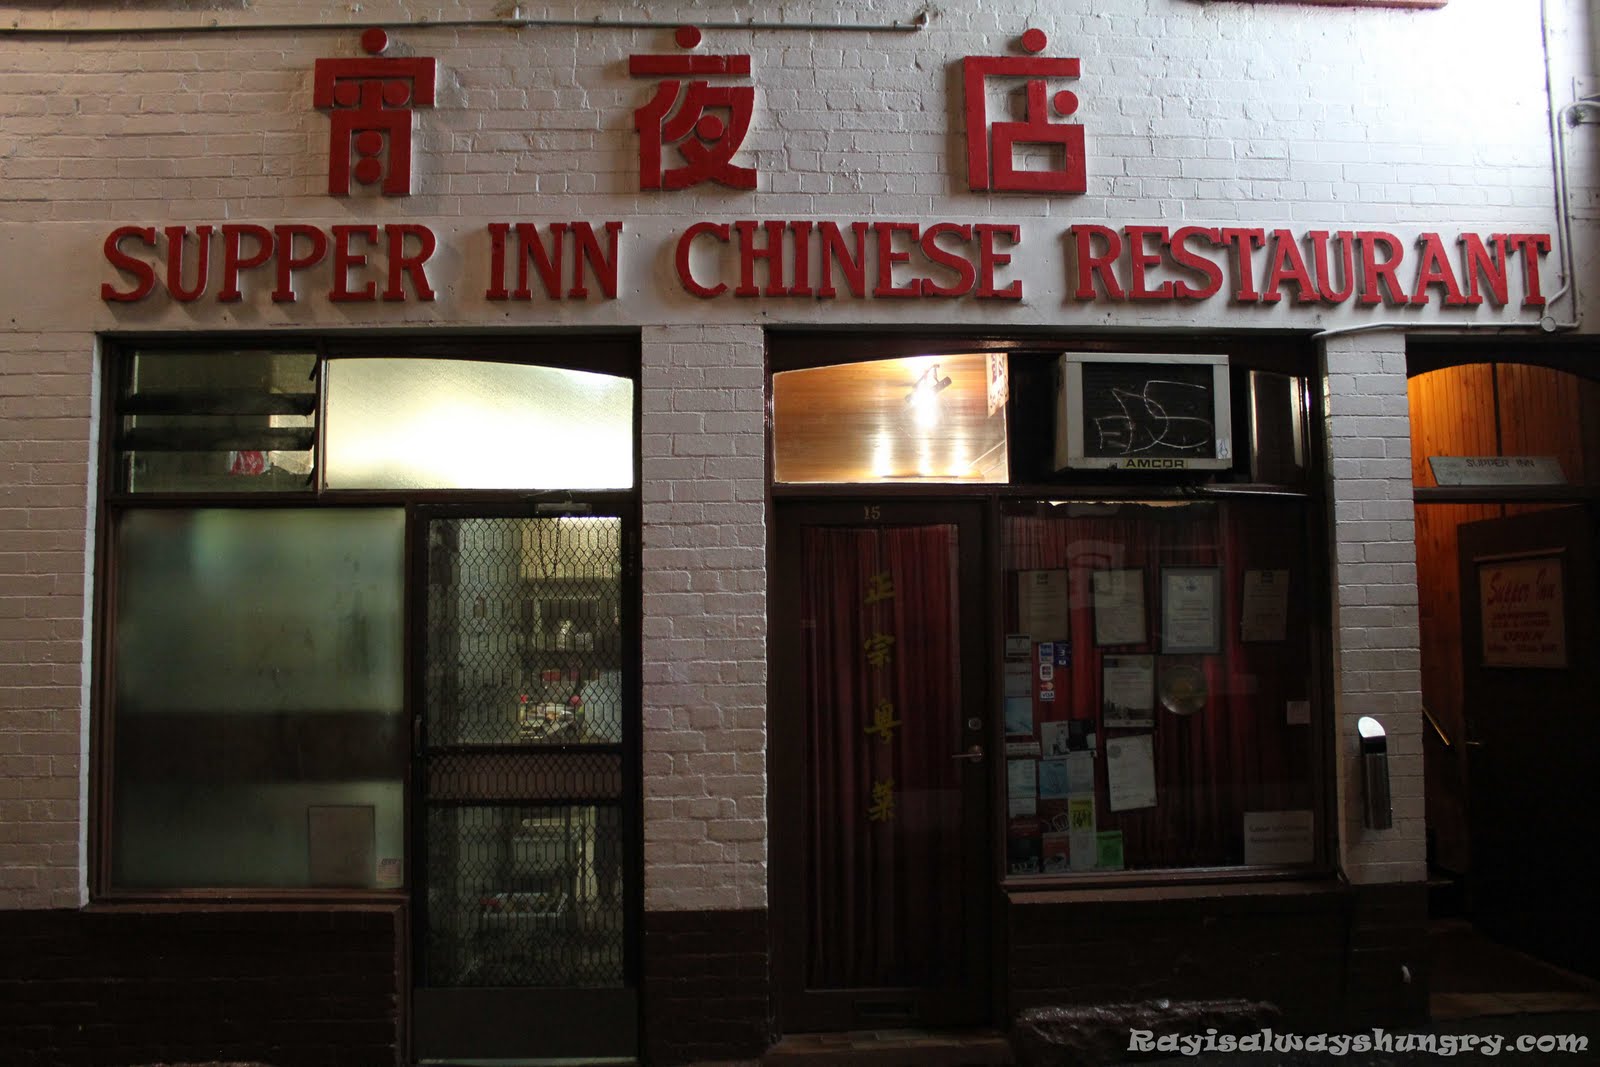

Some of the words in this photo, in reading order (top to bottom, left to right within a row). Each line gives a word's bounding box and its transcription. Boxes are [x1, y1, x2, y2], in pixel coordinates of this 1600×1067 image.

[312, 28, 1087, 193] 宵夜店
[101, 223, 436, 300] SUPPER
[487, 221, 622, 299] INN
[675, 220, 1023, 299] CHINESE
[1071, 224, 1552, 306] RESTAURANT
[1126, 458, 1185, 469] AMCOR
[1466, 458, 1510, 468] SUPPER
[1516, 458, 1535, 467] INN
[863, 505, 881, 521] 15
